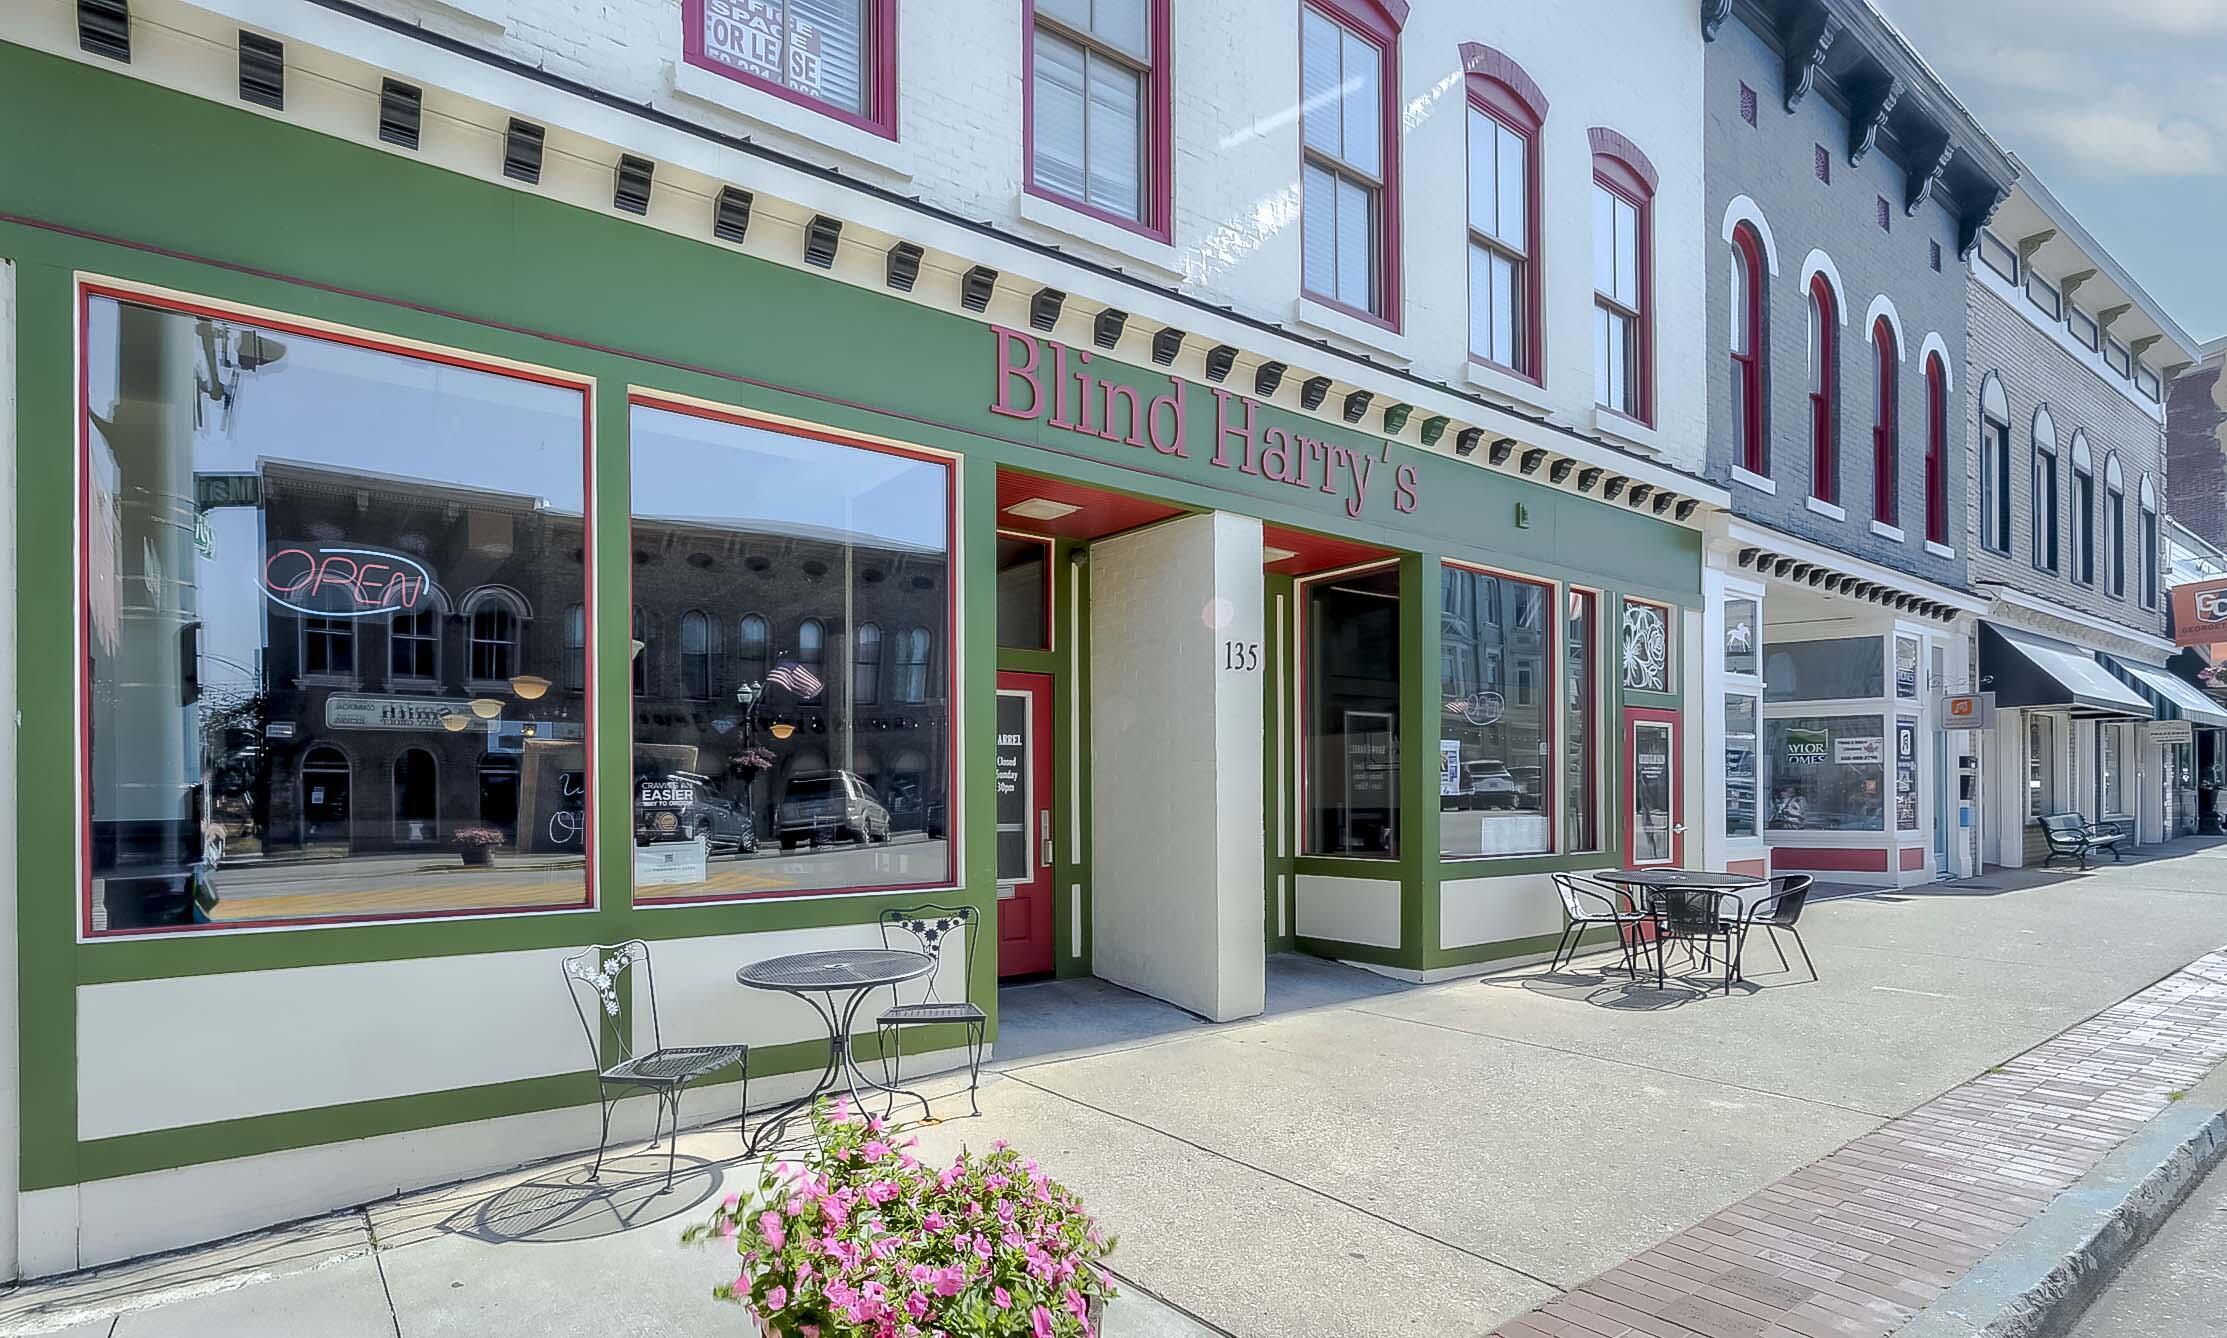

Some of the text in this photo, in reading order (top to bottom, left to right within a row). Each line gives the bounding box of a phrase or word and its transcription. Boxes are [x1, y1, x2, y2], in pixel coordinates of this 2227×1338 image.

[751, 32, 817, 85] LESE
[991, 325, 1416, 519] Blind Harry's
[264, 549, 422, 607] OPEN
[1225, 641, 1257, 671] 135
[642, 790, 694, 801] EASIER
